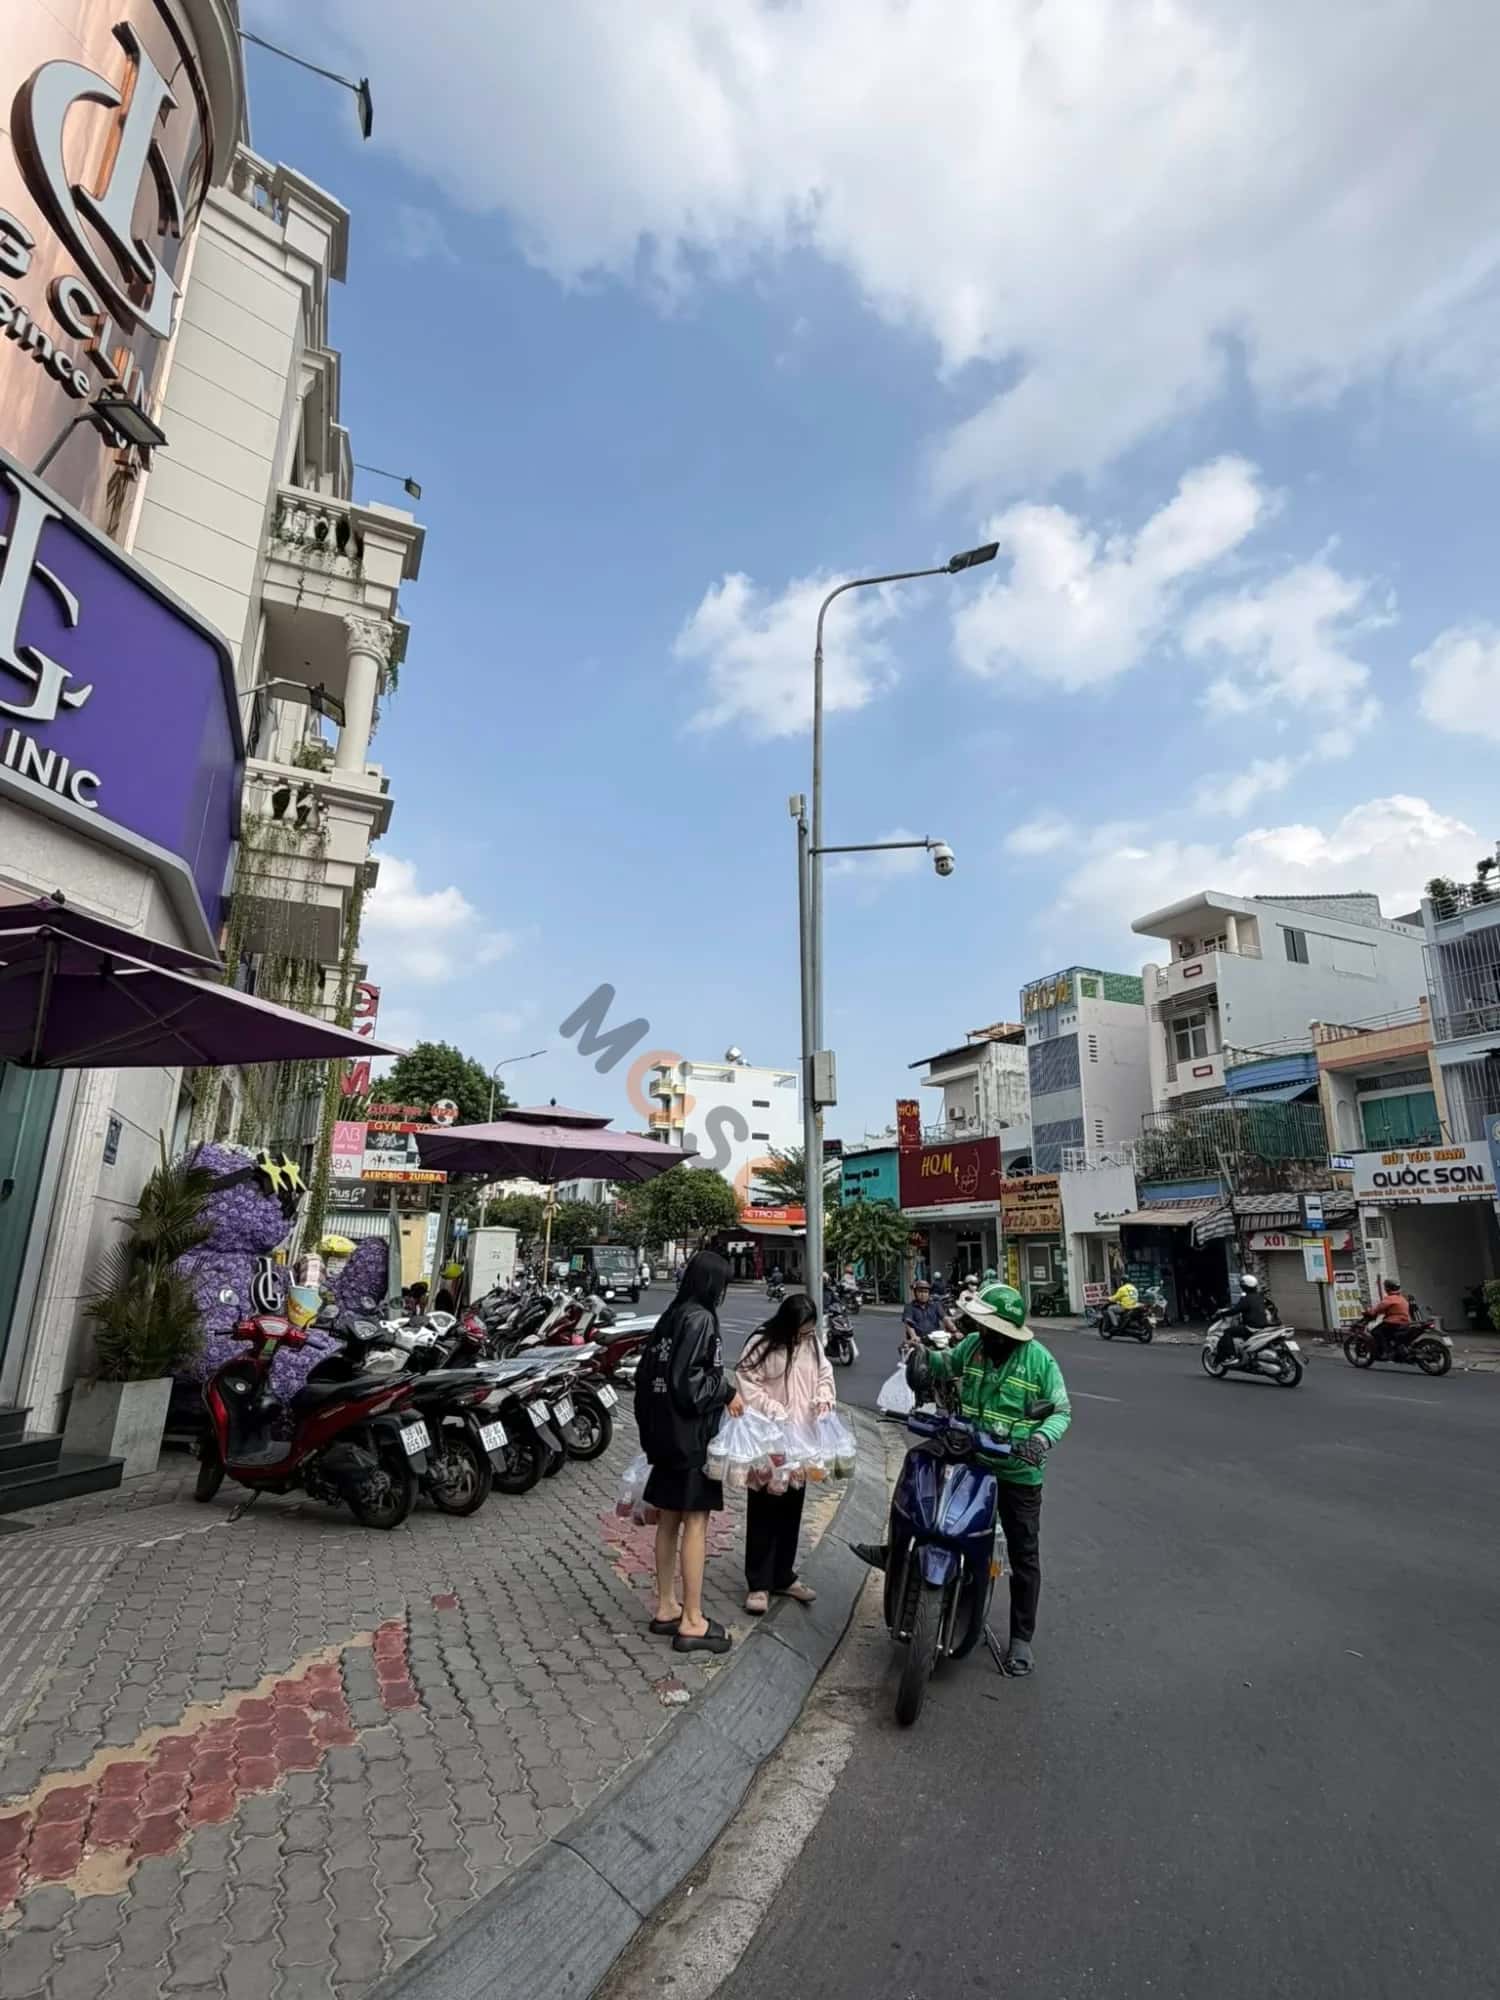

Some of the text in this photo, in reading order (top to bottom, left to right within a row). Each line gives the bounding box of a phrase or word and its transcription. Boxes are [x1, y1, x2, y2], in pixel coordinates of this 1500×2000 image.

[374, 1121, 402, 1132] GYM
[921, 1152, 953, 1177] HQM
[362, 1171, 443, 1182] AEROBIC ZUMBA
[1373, 1164, 1485, 1187] QUỐC SƠN
